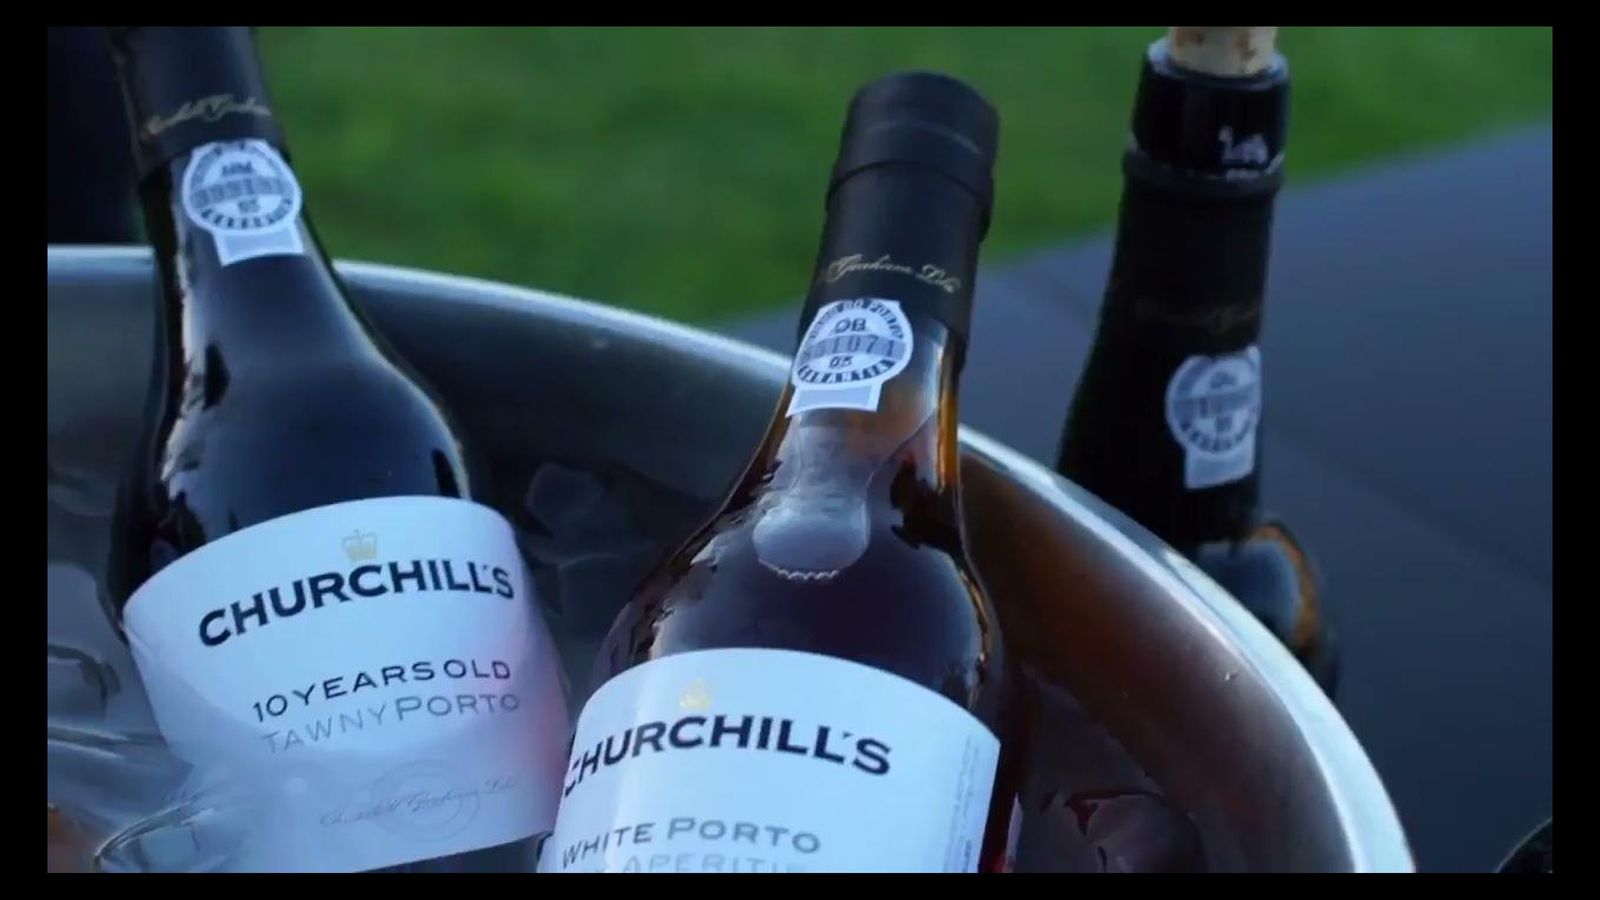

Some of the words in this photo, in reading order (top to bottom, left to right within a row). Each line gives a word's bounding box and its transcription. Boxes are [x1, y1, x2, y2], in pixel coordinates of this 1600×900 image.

[198, 559, 515, 647] CHURCHILL'S
[262, 703, 388, 754] TAWNY
[394, 693, 521, 722] PORTO
[562, 822, 657, 869] WHITE
[666, 816, 821, 854] PORTO
